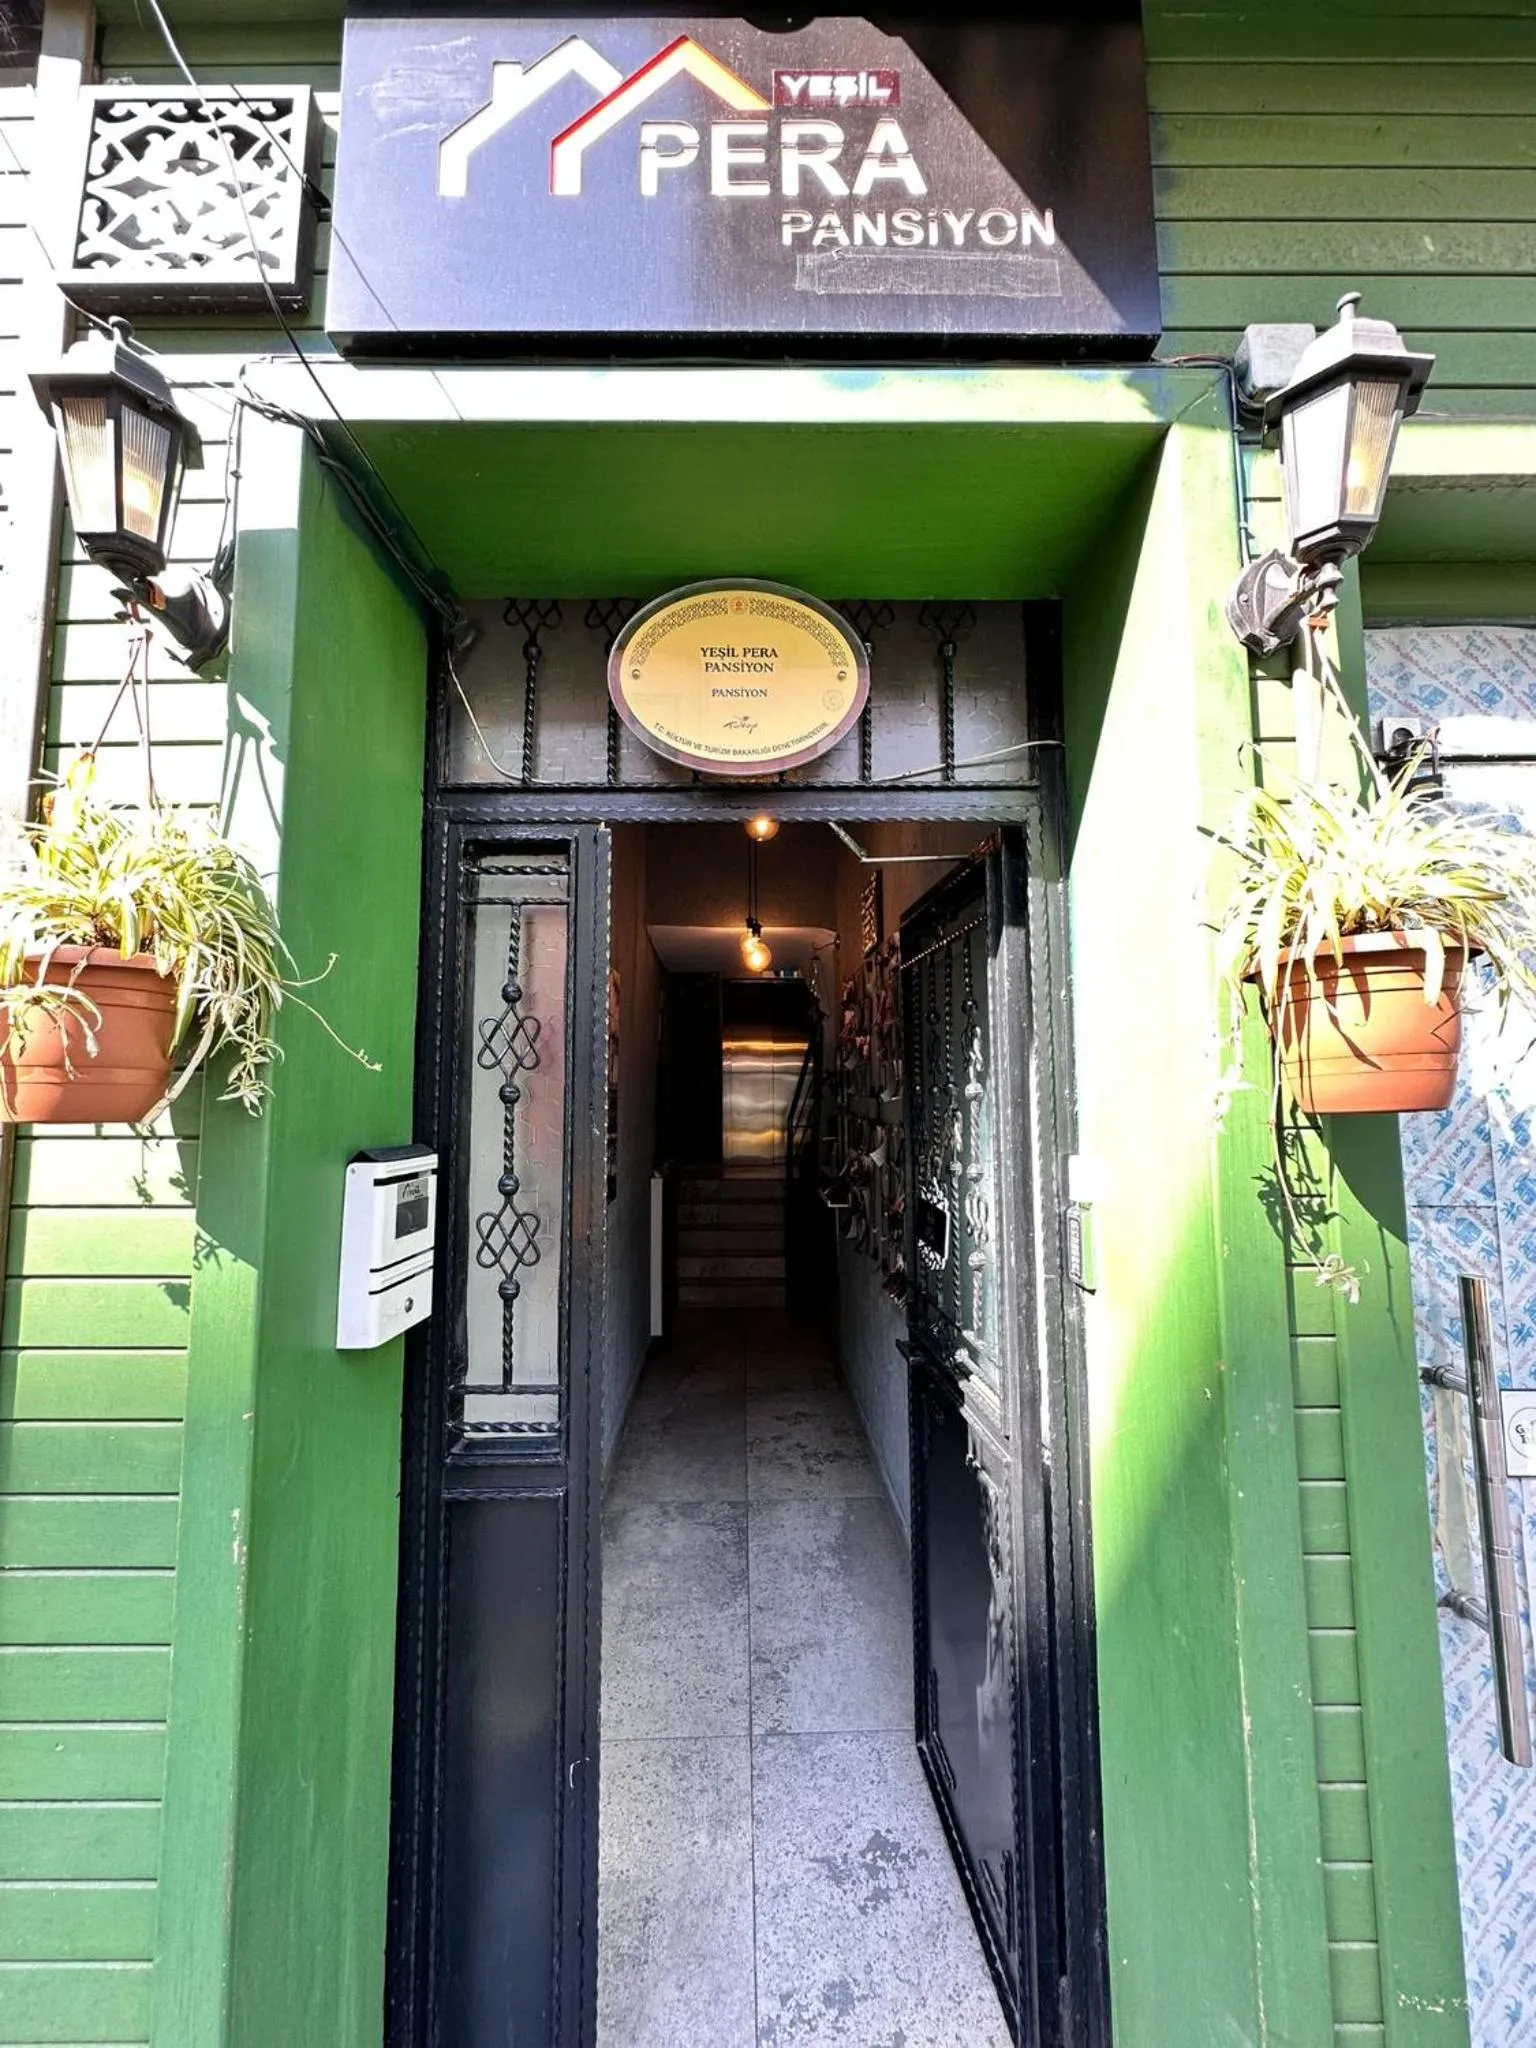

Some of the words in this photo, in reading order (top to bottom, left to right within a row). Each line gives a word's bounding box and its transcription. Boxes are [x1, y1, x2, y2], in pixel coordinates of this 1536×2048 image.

[640, 118, 928, 198] PERA
[700, 645, 739, 660] YEŞİL
[743, 647, 779, 658] PERA
[705, 660, 774, 673] PANSİYON
[712, 686, 768, 698] PANSİYON
